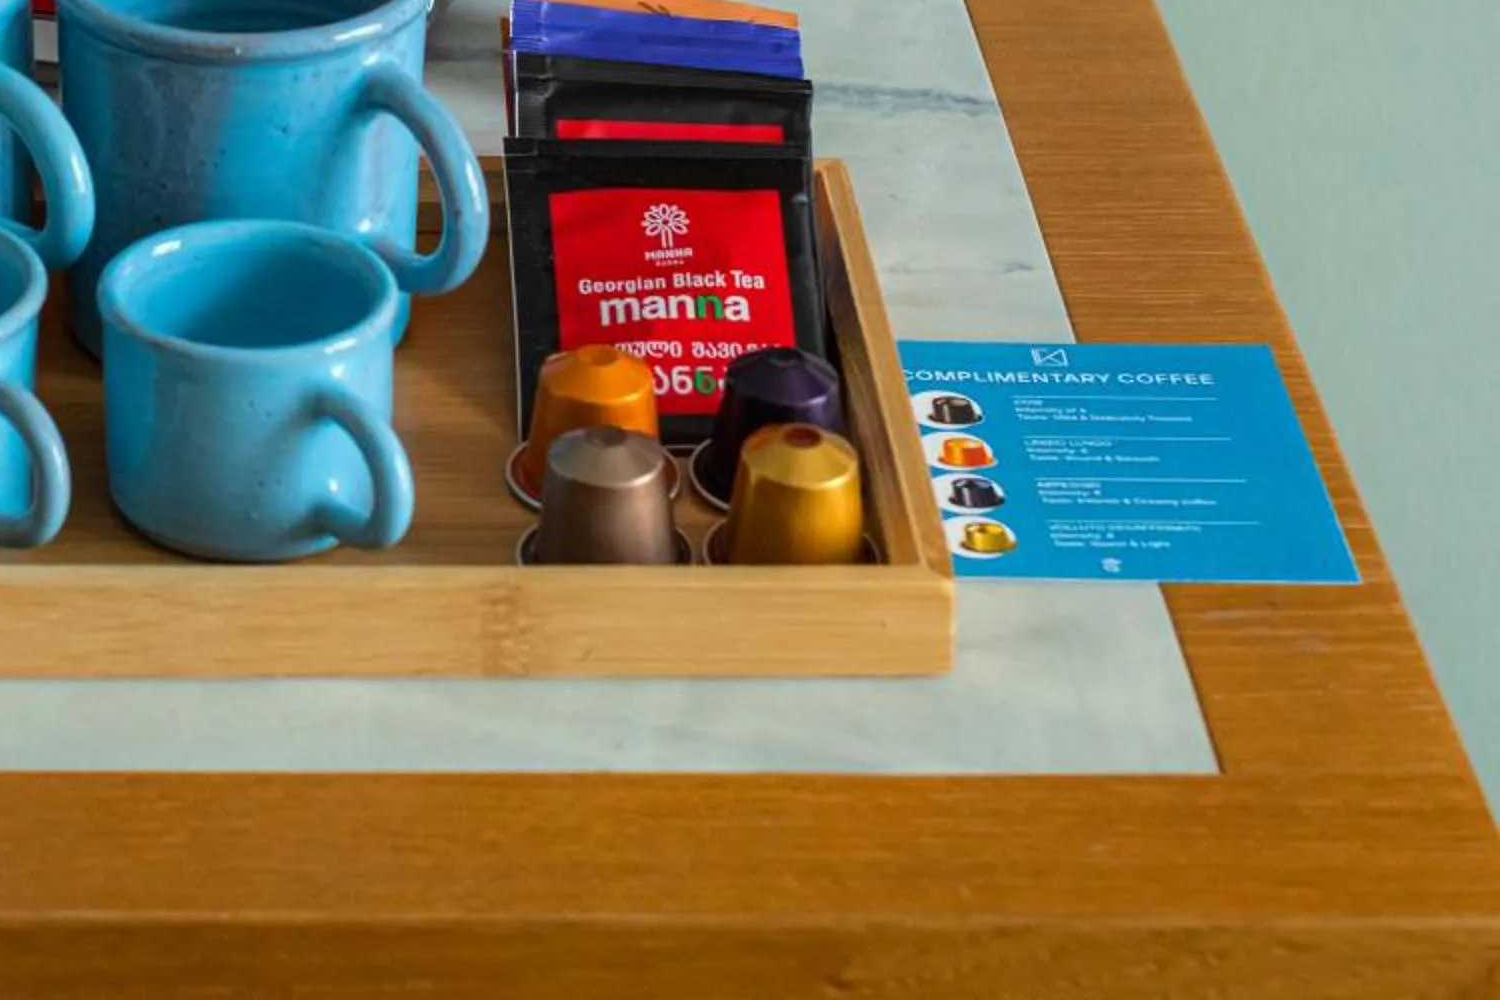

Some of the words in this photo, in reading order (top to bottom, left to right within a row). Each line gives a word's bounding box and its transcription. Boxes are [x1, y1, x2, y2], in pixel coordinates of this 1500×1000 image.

[578, 277, 667, 295] Georgian
[673, 271, 726, 288] Black
[731, 269, 765, 289] Tea
[600, 293, 751, 327] manna
[1117, 372, 1215, 386] COFFEE
